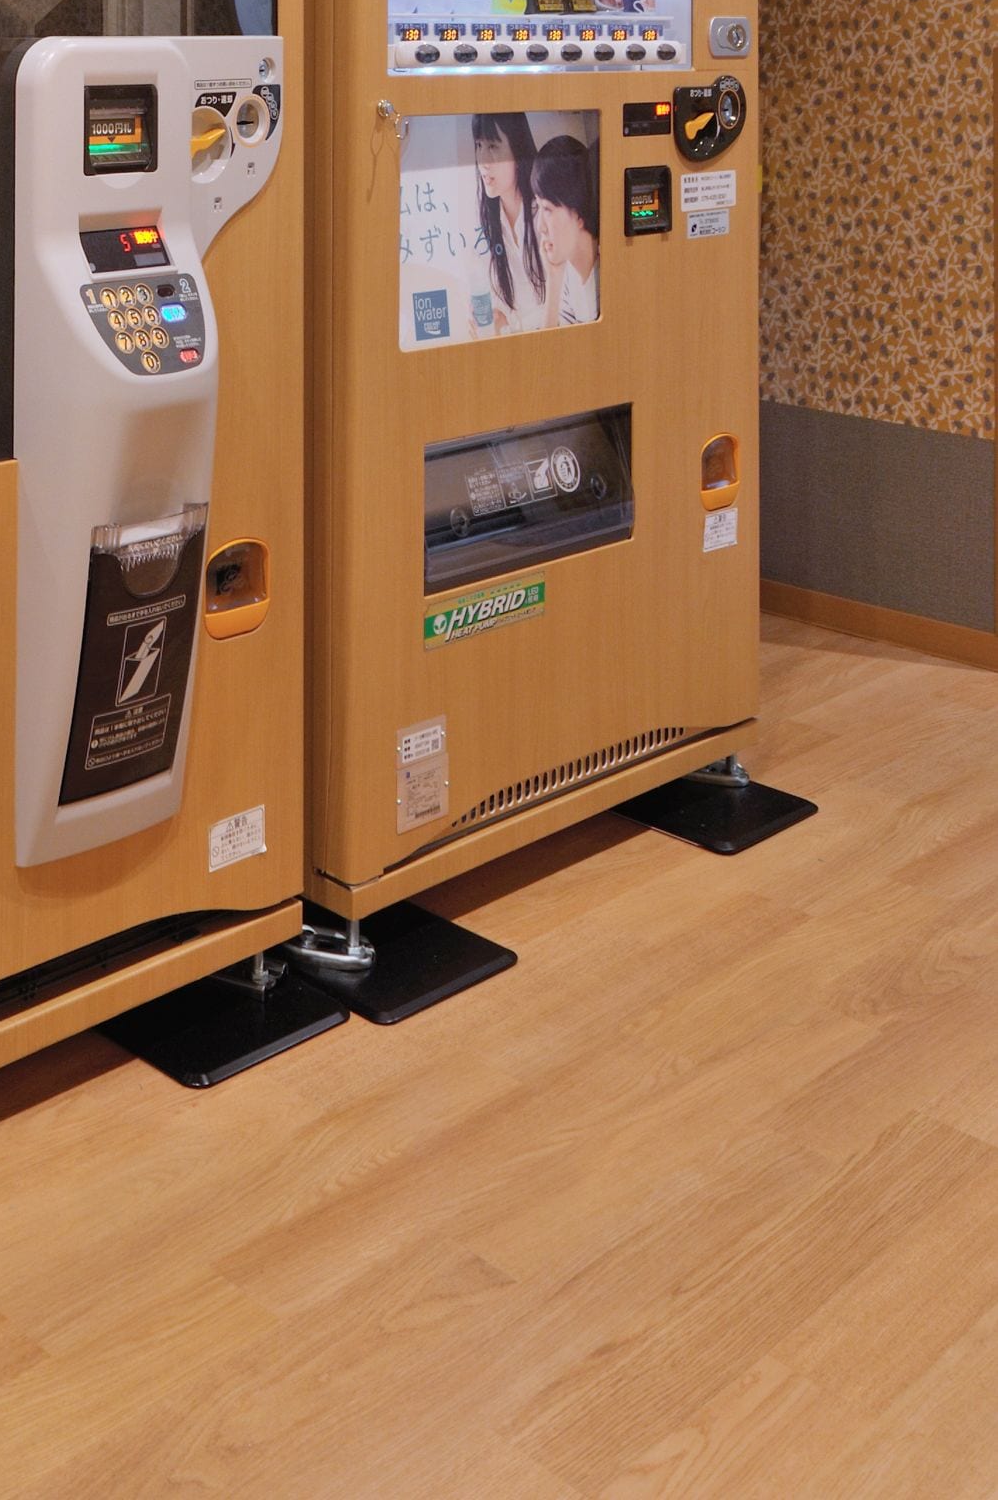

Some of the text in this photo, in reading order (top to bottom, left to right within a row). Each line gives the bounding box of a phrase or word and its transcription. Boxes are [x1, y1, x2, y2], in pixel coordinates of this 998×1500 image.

[91, 122, 132, 135] 1000円札
[179, 278, 191, 293] 2
[85, 288, 97, 304] 1
[122, 291, 131, 303] 2
[139, 289, 148, 301] 3
[414, 295, 432, 309] ion
[113, 310, 156, 325] 4 5 6
[416, 306, 447, 321] water
[120, 336, 129, 350] 7
[138, 335, 147, 347] 8
[155, 332, 164, 344] 9
[146, 355, 155, 367] 0
[445, 589, 526, 642] HYBRID
